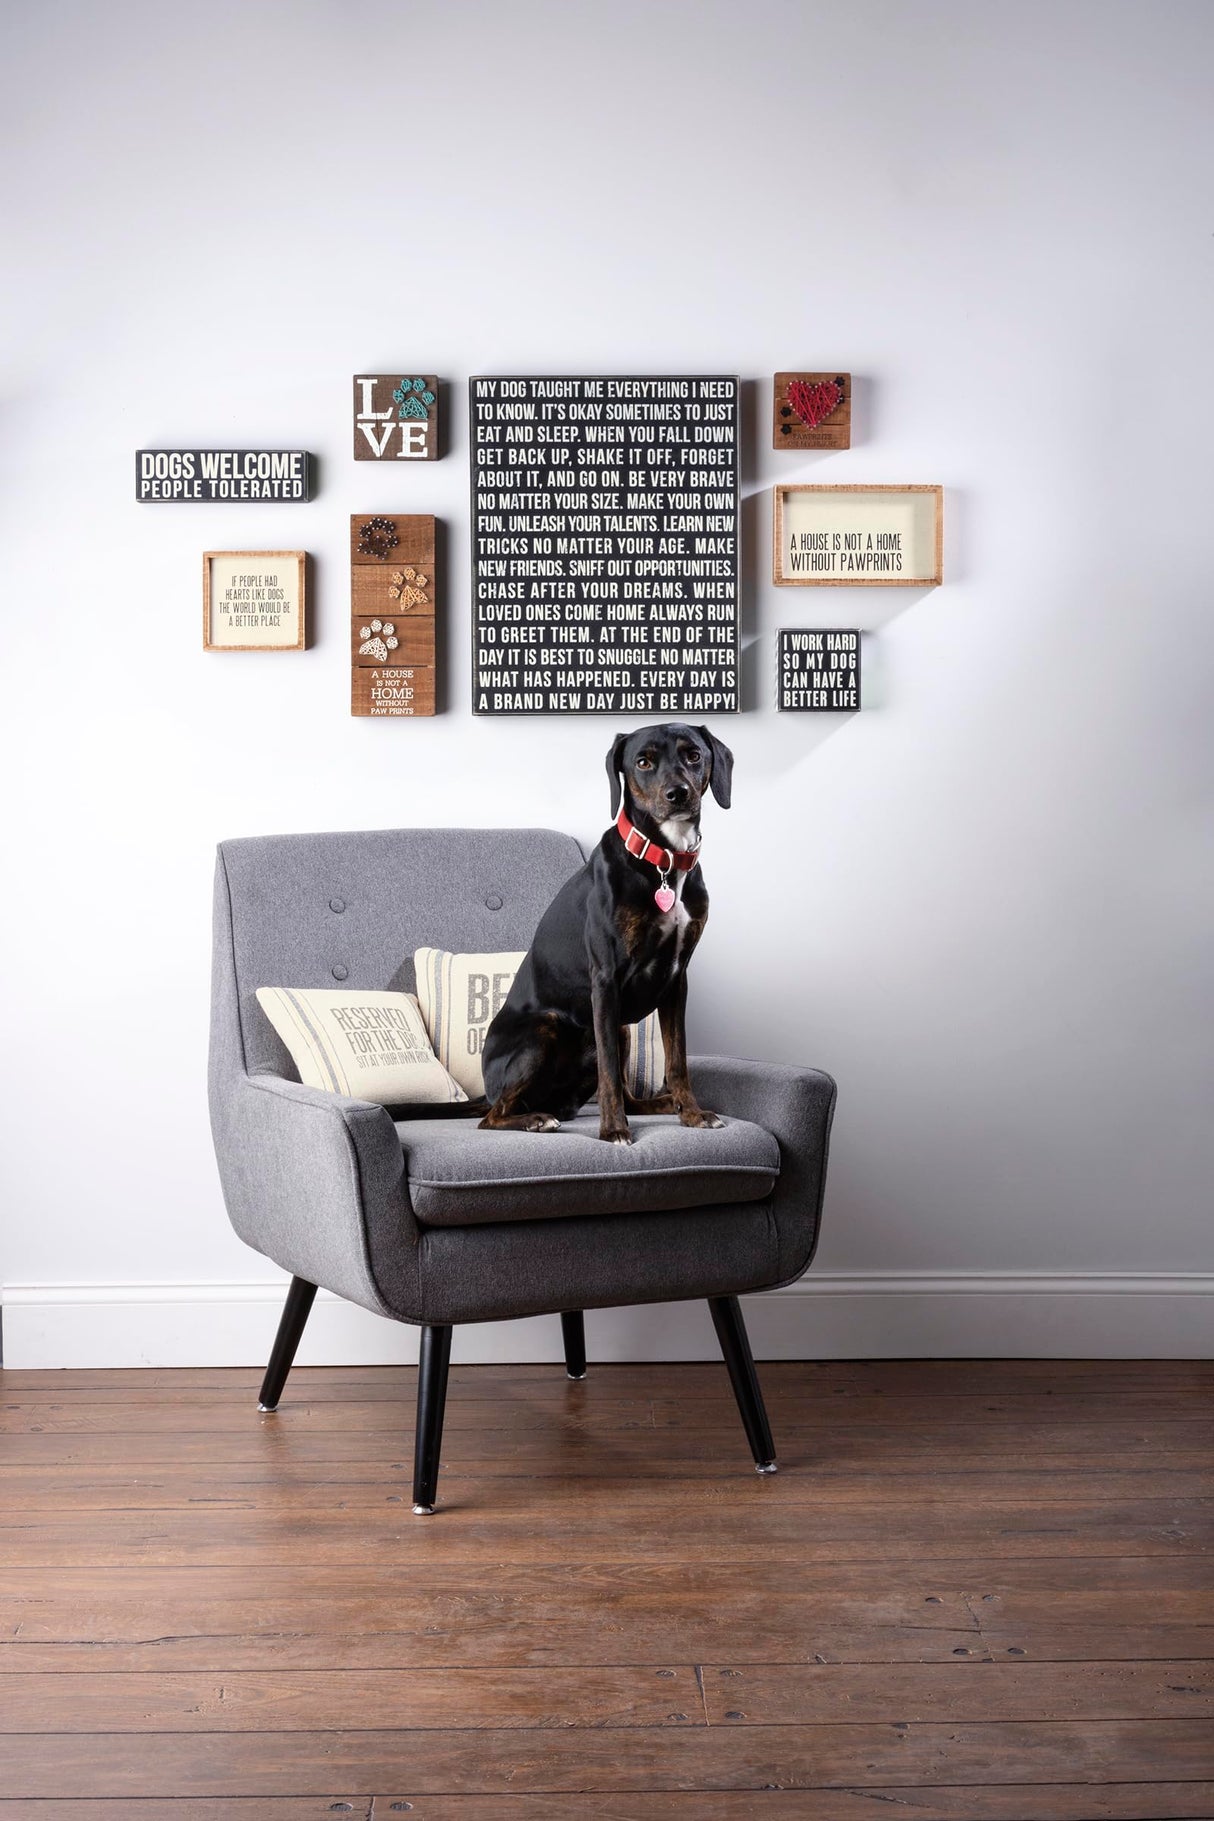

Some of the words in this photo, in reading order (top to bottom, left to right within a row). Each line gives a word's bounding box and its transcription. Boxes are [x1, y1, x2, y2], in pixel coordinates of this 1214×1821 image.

[477, 381, 496, 397] MY
[501, 381, 526, 397] DOG
[530, 381, 581, 397] TAUGHT
[584, 381, 604, 397] ME
[608, 381, 688, 398] EVERYTHING
[692, 382, 696, 398] I
[700, 382, 733, 398] NEED
[476, 404, 493, 420] TO
[497, 404, 538, 420] KNOW.
[542, 404, 566, 420] IT'S
[569, 404, 602, 420] OKAY
[606, 404, 681, 420] SOMETIMES
[684, 404, 700, 420] TO
[704, 404, 734, 420] JUST
[477, 426, 501, 442] EAT
[506, 426, 533, 442] AND
[537, 426, 581, 442] SLEEP.
[585, 426, 624, 442] WHEN
[629, 426, 654, 442] YOU
[659, 426, 690, 442] FALL
[695, 426, 733, 442] DOWN
[477, 448, 503, 465] GET
[509, 448, 546, 465] BACK
[552, 449, 572, 466] UP,
[578, 448, 624, 465] SHAKE
[629, 449, 642, 464] IT
[647, 448, 675, 466] OFF,
[681, 449, 734, 465] FORGET
[142, 453, 195, 479] DOGS
[200, 453, 301, 479] WELCOME
[478, 471, 522, 487] ABOUT
[527, 471, 542, 489] IT,
[547, 471, 575, 487] AND
[580, 471, 597, 487] GO
[602, 471, 624, 487] ON.
[629, 471, 646, 487] BE
[650, 471, 685, 487] VERY
[690, 471, 734, 487] BRAVE
[141, 480, 202, 498] PEOPLE
[209, 480, 302, 498] TOLERATED
[478, 493, 495, 510] NO
[499, 493, 550, 509] MATTER
[554, 493, 588, 509] YOUR
[591, 493, 623, 509] SIZE.
[627, 493, 664, 509] MAKE
[667, 493, 701, 509] YOUR
[705, 493, 734, 509] OWN
[478, 516, 506, 532] FUN.
[509, 515, 565, 532] UNLEASH
[568, 515, 601, 532] YOUR
[603, 515, 660, 532] TALENTS.
[664, 516, 703, 532] LEARN
[706, 516, 734, 532] NEW
[478, 538, 528, 554] TRICKS
[533, 538, 551, 554] NO
[557, 538, 612, 554] MATTER
[617, 538, 653, 554] YOUR
[659, 538, 690, 554] AGE.
[695, 538, 734, 554] MAKE
[790, 533, 797, 550] A
[801, 533, 829, 550] HOUSE
[833, 533, 841, 550] IS
[845, 533, 862, 550] NOT
[866, 533, 873, 550] A
[877, 533, 901, 550] HOME
[479, 560, 507, 576] NEW
[510, 560, 566, 576] FRIENDS.
[569, 560, 605, 576] SNIFF
[608, 560, 632, 576] OUT
[635, 560, 734, 576] OPPORTUNITIES.
[790, 553, 836, 571] WITHOUT
[841, 553, 902, 571] PAWPRINTS
[232, 576, 237, 586] IF
[240, 575, 262, 587] PEOPLE
[265, 575, 277, 587] HAD
[226, 589, 250, 600] HEARTS
[252, 589, 265, 600] LIKE
[268, 588, 284, 600] DOGS
[479, 583, 525, 599] CHASE
[531, 582, 575, 598] AFTER
[581, 582, 618, 598] YOUR
[624, 582, 687, 598] DREAMS.
[693, 582, 734, 598] WHEN
[219, 602, 230, 613] THE
[233, 602, 256, 613] WORLD
[258, 602, 281, 613] WOULD
[283, 602, 290, 613] BE
[479, 605, 521, 621] LOVED
[526, 604, 561, 621] ONES
[565, 604, 602, 620] COME
[607, 604, 645, 620] HOME
[650, 604, 703, 621] ALWAYS
[708, 604, 734, 620] RUN
[229, 616, 233, 626] A
[236, 615, 259, 627] BETTER
[261, 615, 280, 626] PLACE
[478, 627, 496, 643] TO
[501, 627, 545, 643] GREET
[550, 627, 594, 643] THEM.
[600, 627, 617, 642] AT
[621, 627, 648, 642] THE
[654, 627, 681, 643] END
[686, 627, 703, 643] OF
[708, 627, 734, 643] THE
[784, 634, 787, 650] I
[791, 634, 823, 650] WORK
[827, 634, 856, 650] HARD
[479, 649, 504, 665] DAY
[508, 649, 520, 665] IT
[525, 649, 536, 665] IS
[541, 649, 574, 665] BEST
[577, 649, 594, 665] TO
[598, 649, 656, 665] SNUGGLE
[661, 649, 678, 665] NO
[683, 649, 734, 665] MATTER
[784, 653, 799, 669] SO
[806, 653, 823, 669] MY
[831, 653, 856, 669] DOG
[371, 670, 379, 678] A
[382, 670, 414, 678] HOUSE
[479, 671, 519, 687] WHAT
[524, 671, 551, 687] HAS
[557, 671, 635, 687] HAPPENED.
[641, 671, 685, 687] EVERY
[690, 671, 717, 687] DAY
[722, 671, 735, 687] IS
[784, 672, 807, 688] CAN
[813, 672, 843, 688] HAVE
[849, 672, 856, 688] A
[371, 688, 413, 699] HOME
[479, 693, 488, 709] A
[494, 693, 543, 709] BRAND
[549, 693, 581, 709] NEW
[587, 693, 614, 709] DAY
[620, 693, 654, 709] JUST
[660, 693, 678, 709] BE
[684, 693, 735, 709] HAPPY!
[784, 691, 827, 707] BETTER
[833, 690, 856, 706] LIFE
[330, 1006, 411, 1032] RESERVED
[345, 1031, 377, 1055] FOR
[370, 1029, 402, 1052] THE
[356, 1054, 371, 1069] SIT
[369, 1053, 381, 1067] AT
[377, 1052, 400, 1066] YOUR
[397, 1051, 417, 1065] OWN
